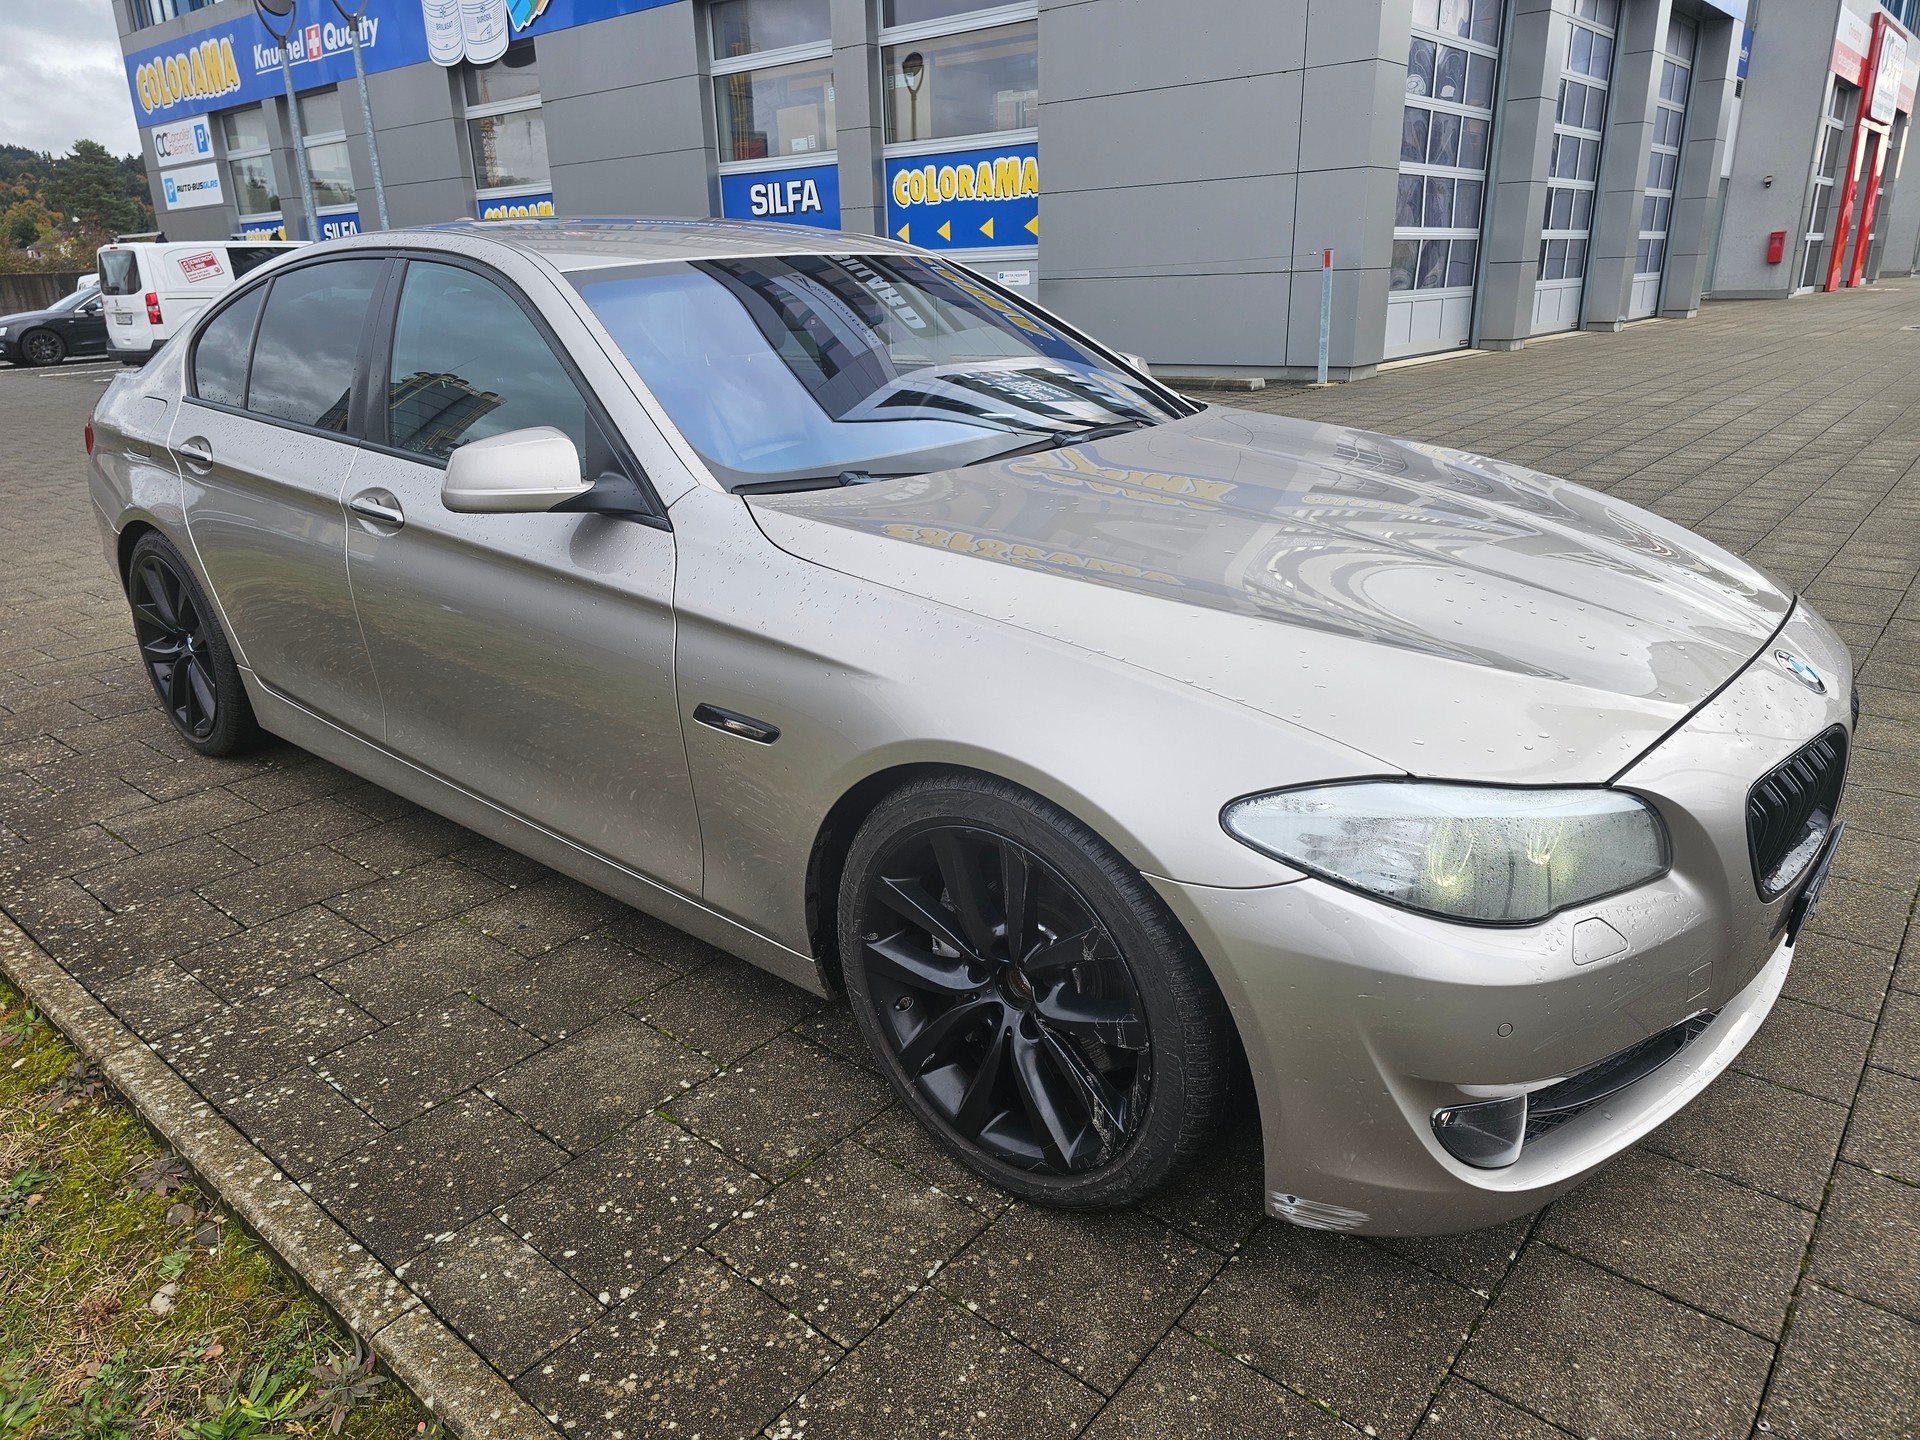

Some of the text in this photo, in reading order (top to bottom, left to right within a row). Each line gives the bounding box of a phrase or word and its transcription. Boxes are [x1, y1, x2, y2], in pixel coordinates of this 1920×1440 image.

[323, 12, 379, 51] Quaity
[136, 37, 241, 115] COLORAMA
[750, 179, 823, 217] SILFA
[893, 156, 1039, 209] COLORAMA
